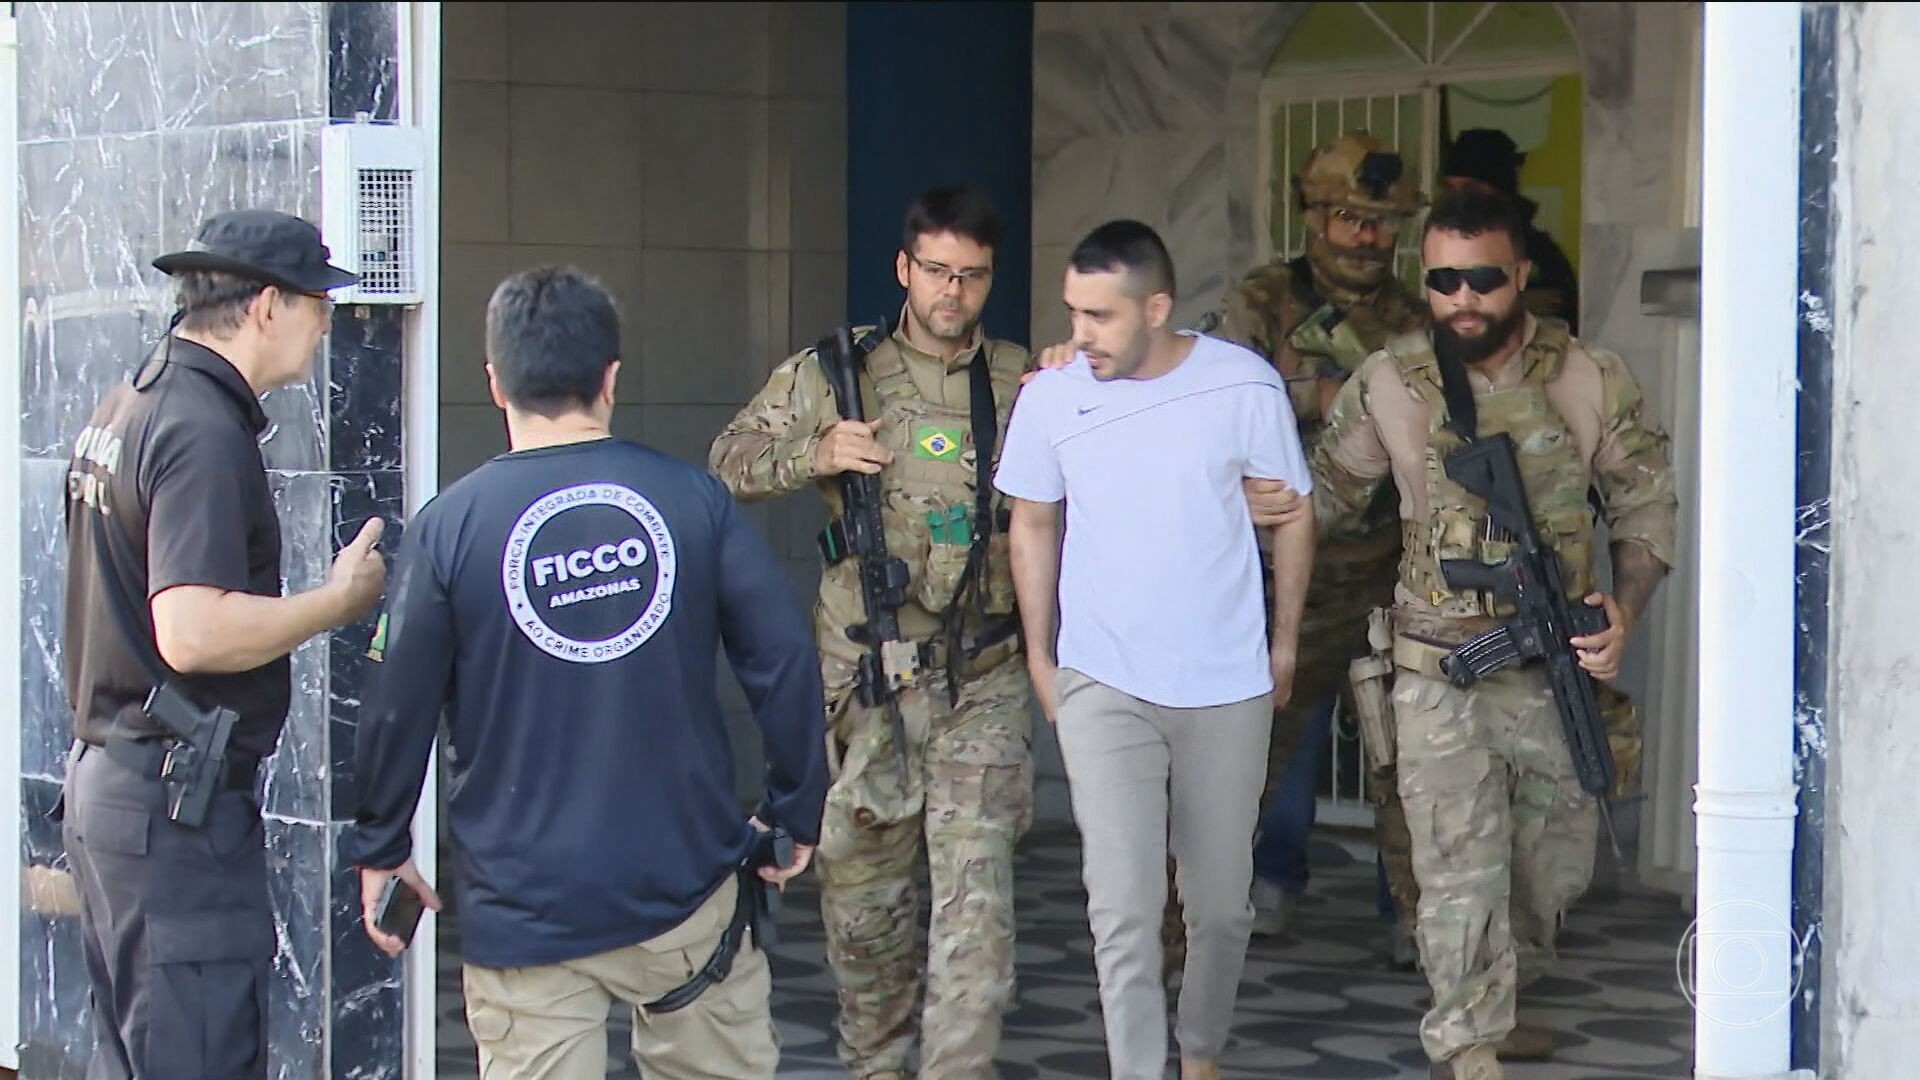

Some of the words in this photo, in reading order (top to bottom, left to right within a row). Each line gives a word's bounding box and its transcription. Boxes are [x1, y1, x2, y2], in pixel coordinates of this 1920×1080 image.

[520, 489, 597, 534] INTEGRADA
[602, 489, 623, 499] DE
[625, 495, 670, 559] COMBATE
[531, 537, 648, 587] FICCO
[549, 577, 642, 608] AMAZONAS
[526, 619, 544, 638] AO
[544, 637, 589, 658] CRIME
[593, 593, 670, 658] ORGANIZADO
